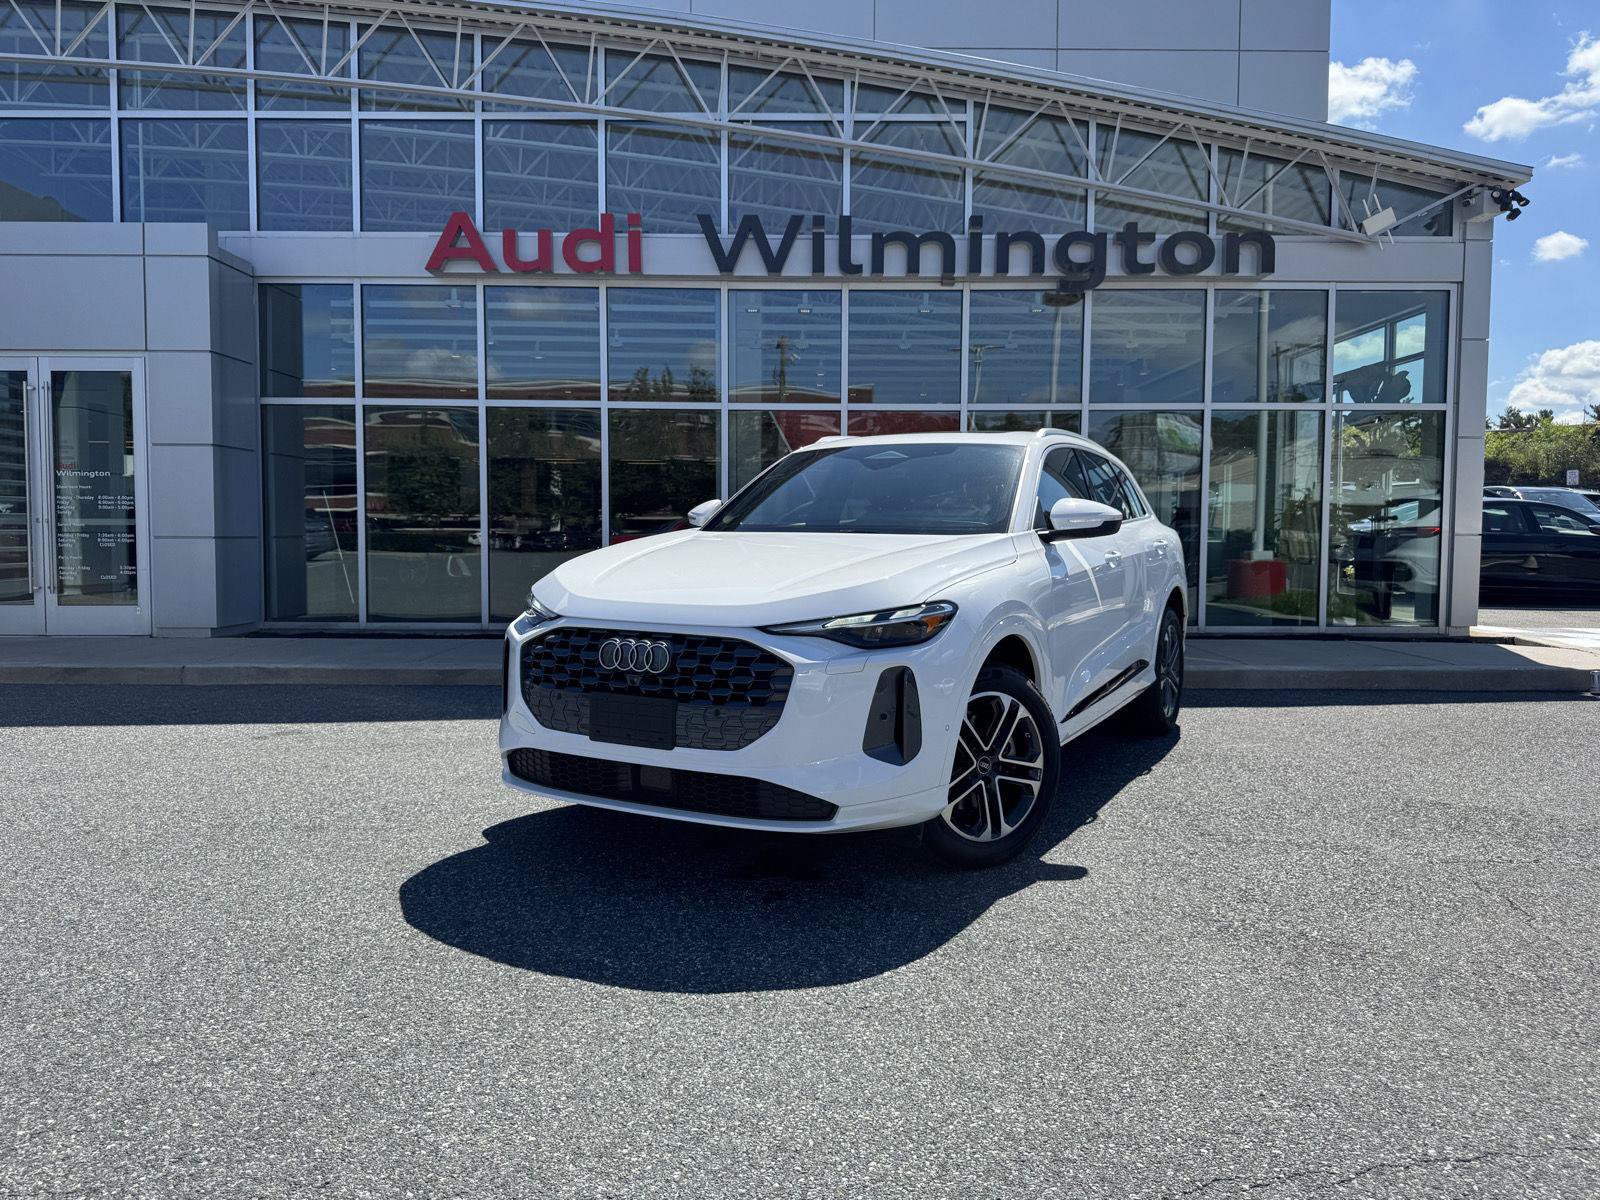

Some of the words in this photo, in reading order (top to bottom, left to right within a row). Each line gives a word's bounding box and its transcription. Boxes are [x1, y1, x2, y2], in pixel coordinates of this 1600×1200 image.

[425, 211, 643, 275] Audi
[697, 214, 1276, 291] Wilmington
[56, 470, 111, 478] Wilmington
